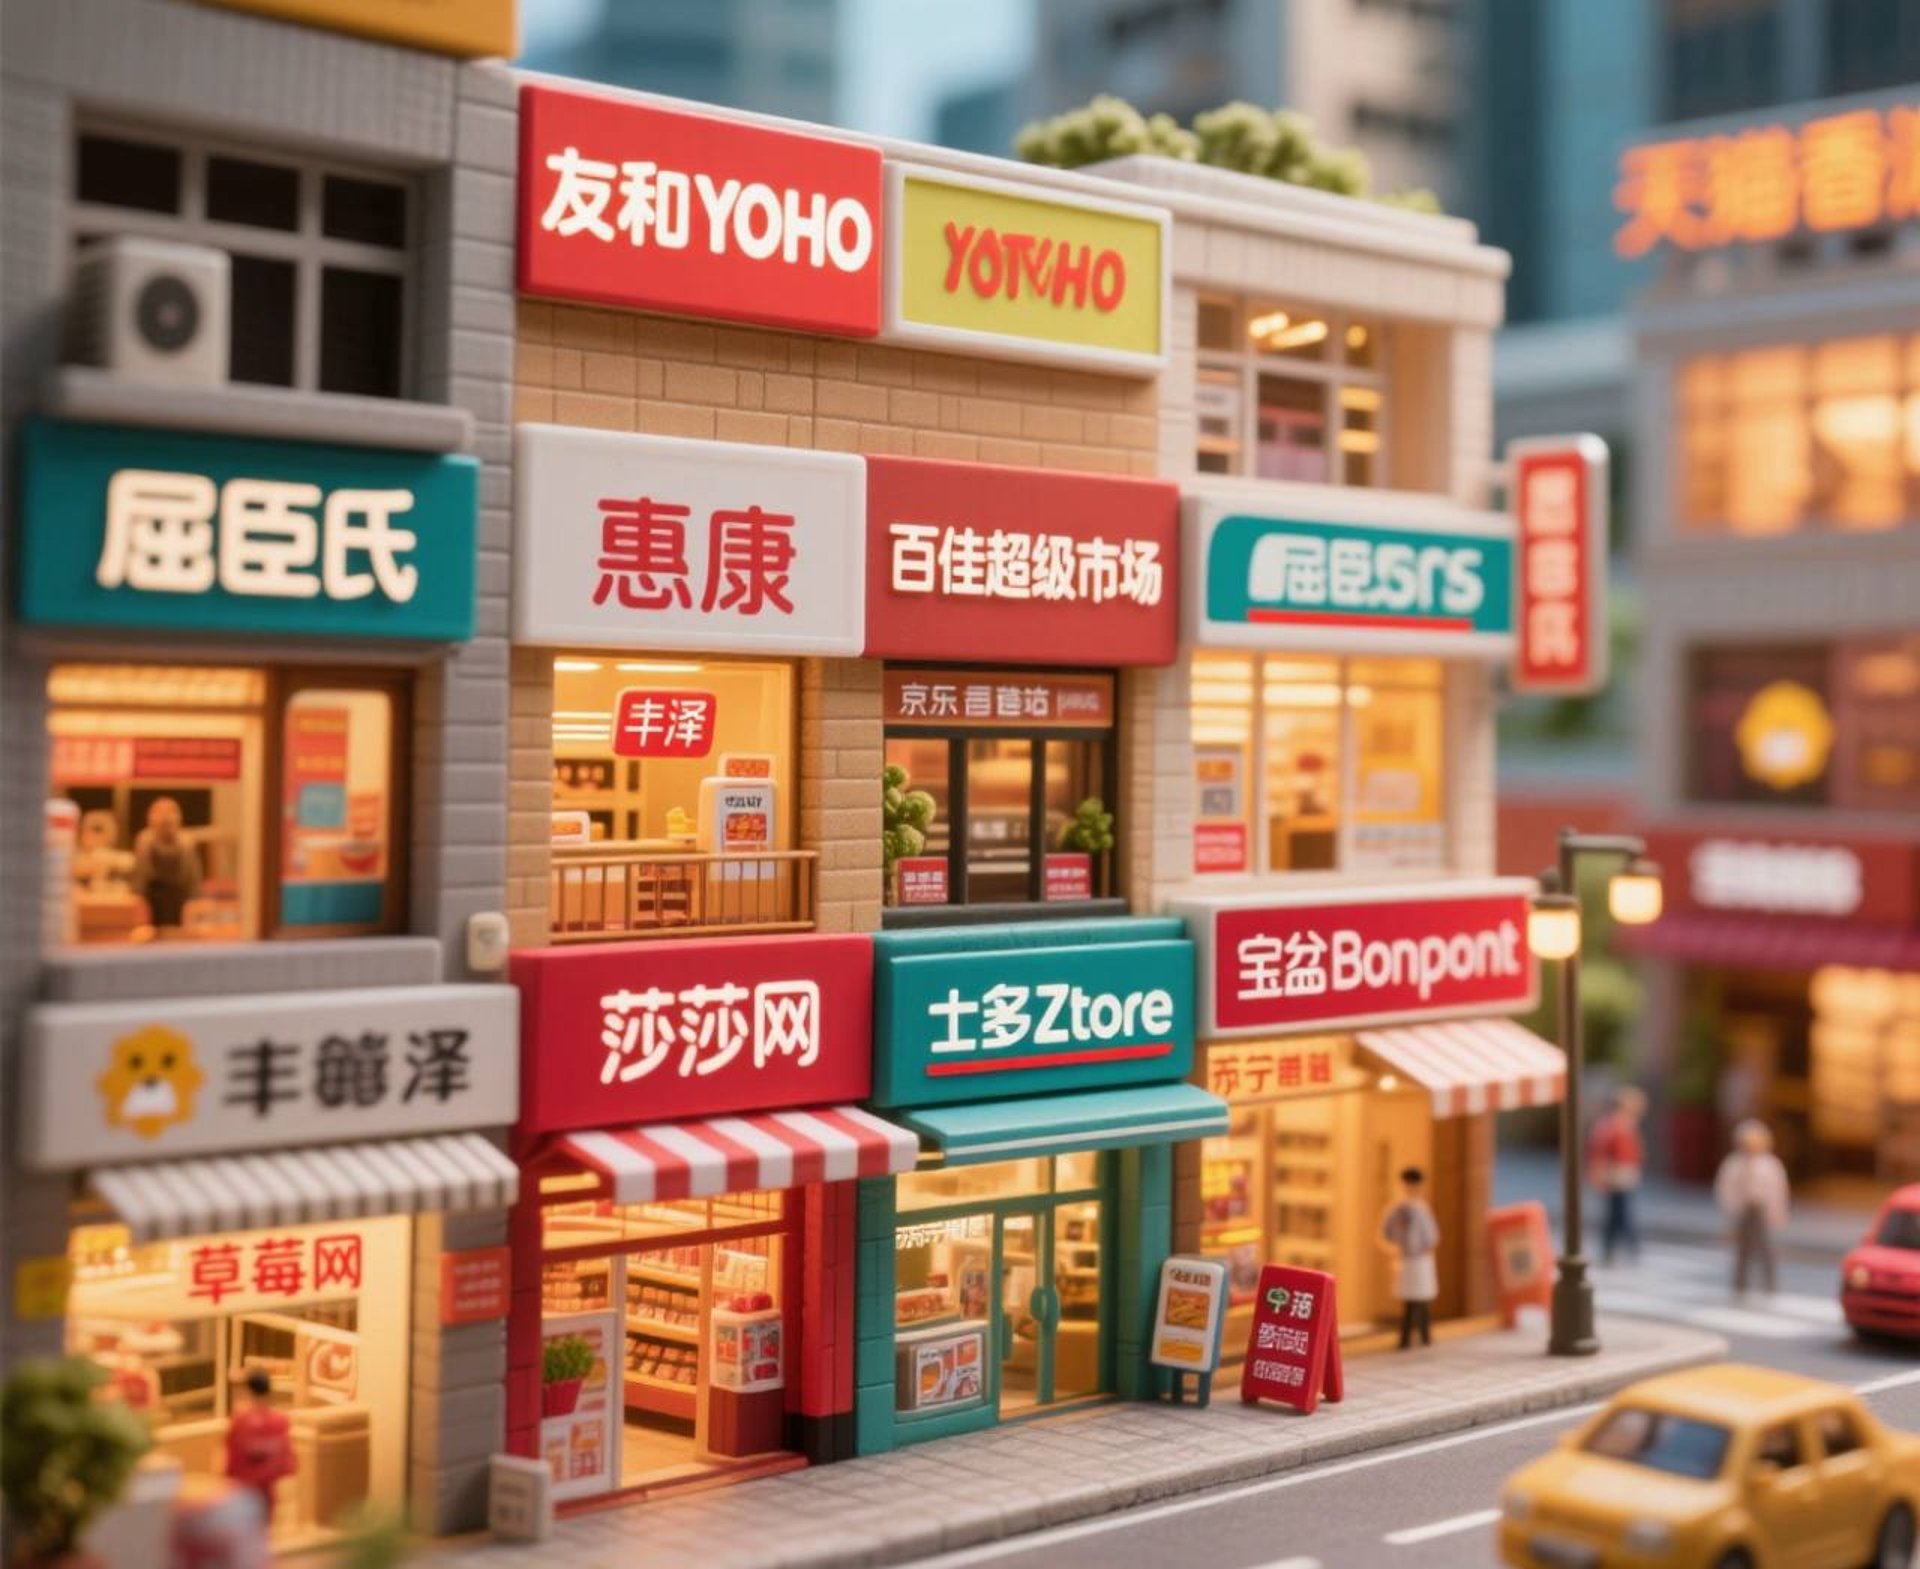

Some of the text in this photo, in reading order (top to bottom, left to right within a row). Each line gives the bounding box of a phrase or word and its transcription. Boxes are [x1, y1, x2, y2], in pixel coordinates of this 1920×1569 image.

[541, 146, 874, 273] 友和YOHO
[592, 496, 797, 616] 惠康
[888, 522, 1164, 607] 百佳超级市场
[624, 697, 709, 748] 丰泽
[1237, 919, 1522, 1002] 宝盆Bonpont
[600, 978, 820, 1086] 莎莎网
[927, 983, 1175, 1055] 士多Ztore
[187, 1234, 363, 1304] 草莓网
